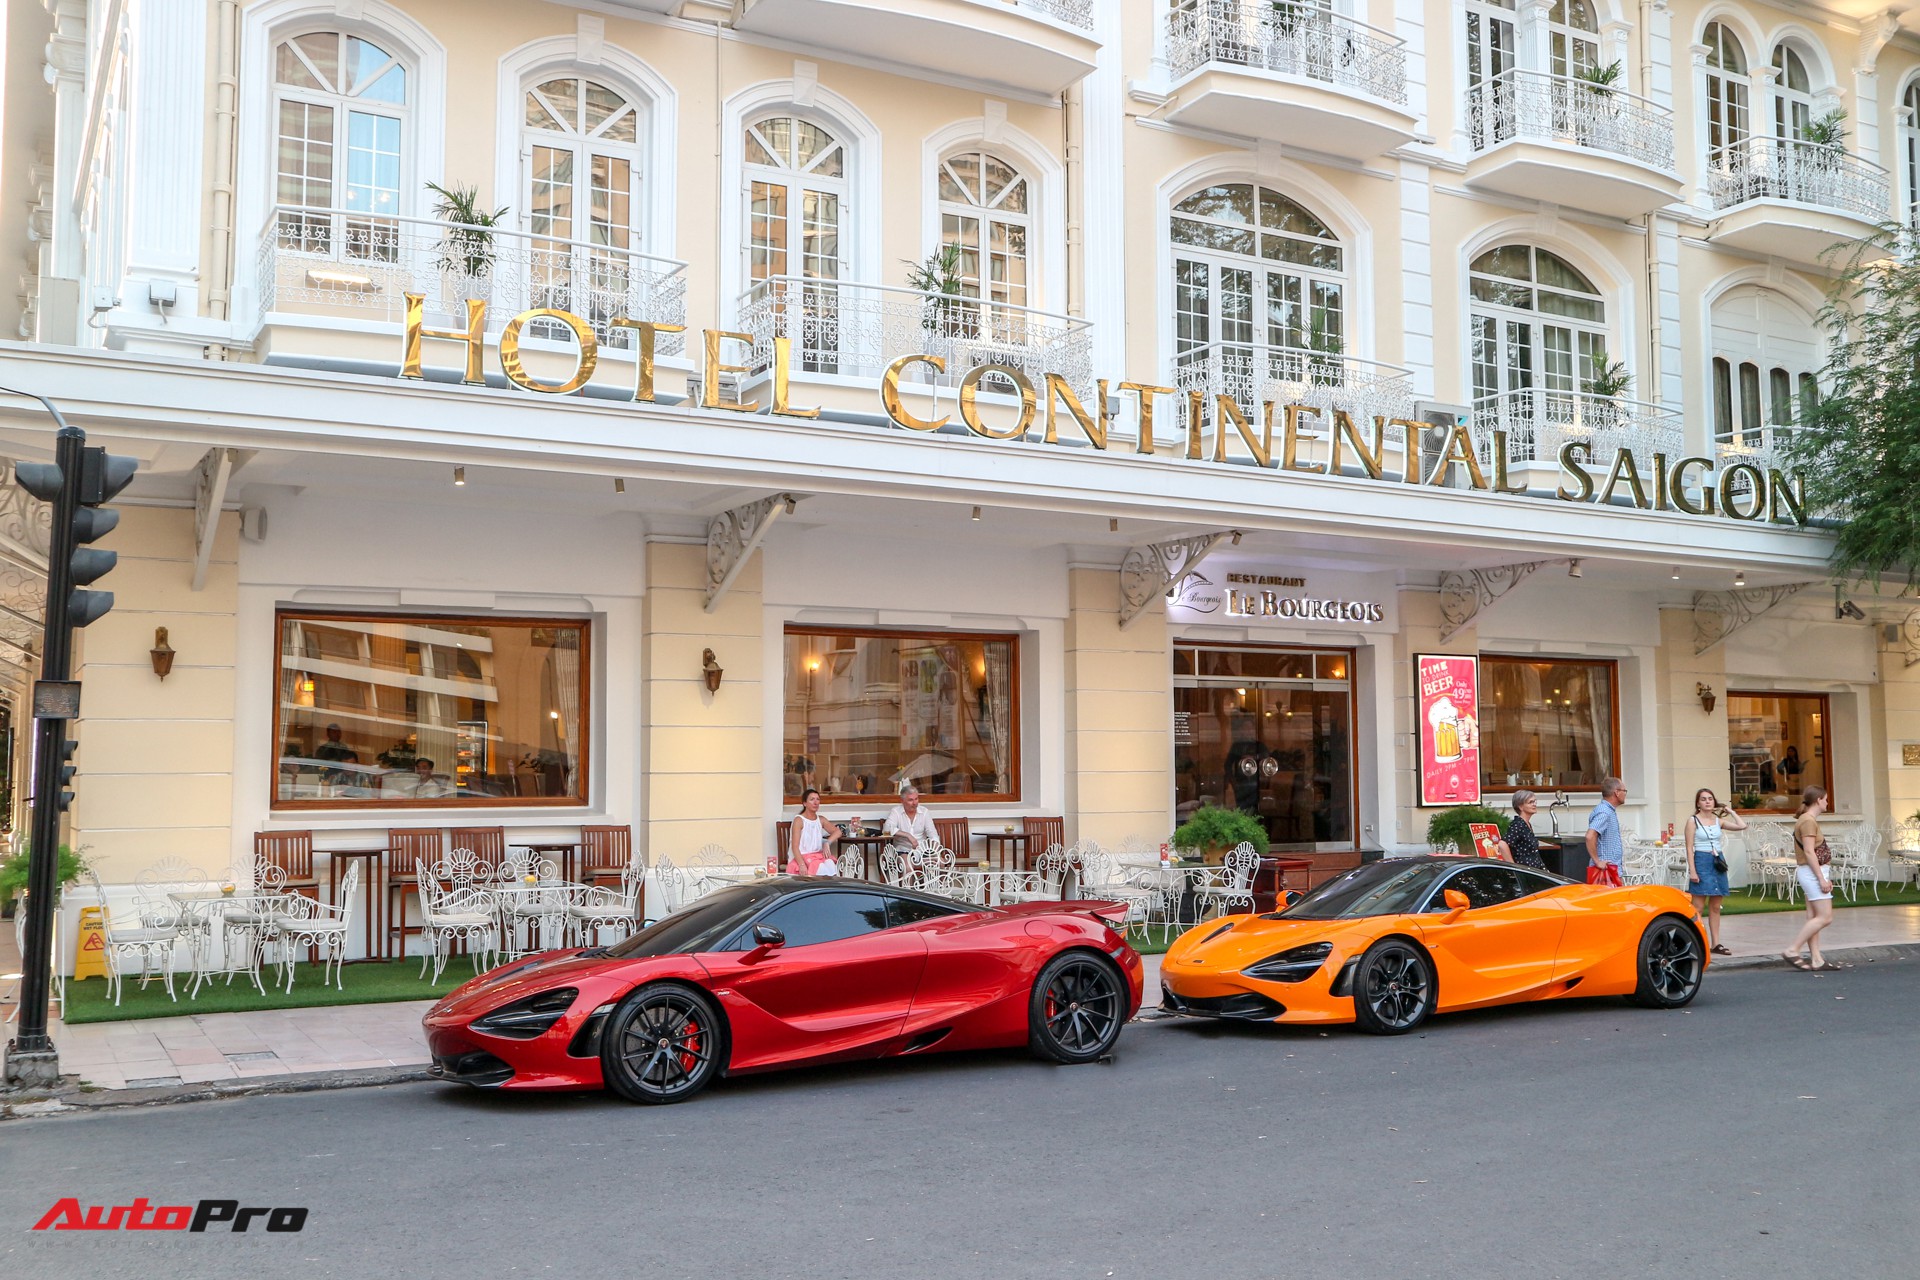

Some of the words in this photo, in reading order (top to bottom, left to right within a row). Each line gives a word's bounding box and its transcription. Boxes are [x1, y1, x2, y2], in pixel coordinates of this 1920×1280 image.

[398, 291, 821, 421] HOTEL
[879, 354, 1527, 494] CONTINENTAL
[1556, 441, 1808, 526] SAIGON
[1227, 572, 1306, 587] RESTAURANT
[1225, 588, 1255, 616] LE
[1260, 589, 1384, 622] BOURGEOIS
[1421, 661, 1448, 677] TIME
[1431, 670, 1449, 680] DRINK
[1423, 675, 1454, 697] BEER
[1452, 687, 1465, 699] 49
[1426, 768, 1443, 779] DAILY
[1445, 763, 1457, 772] 2PM
[1463, 755, 1476, 765] 7PM
